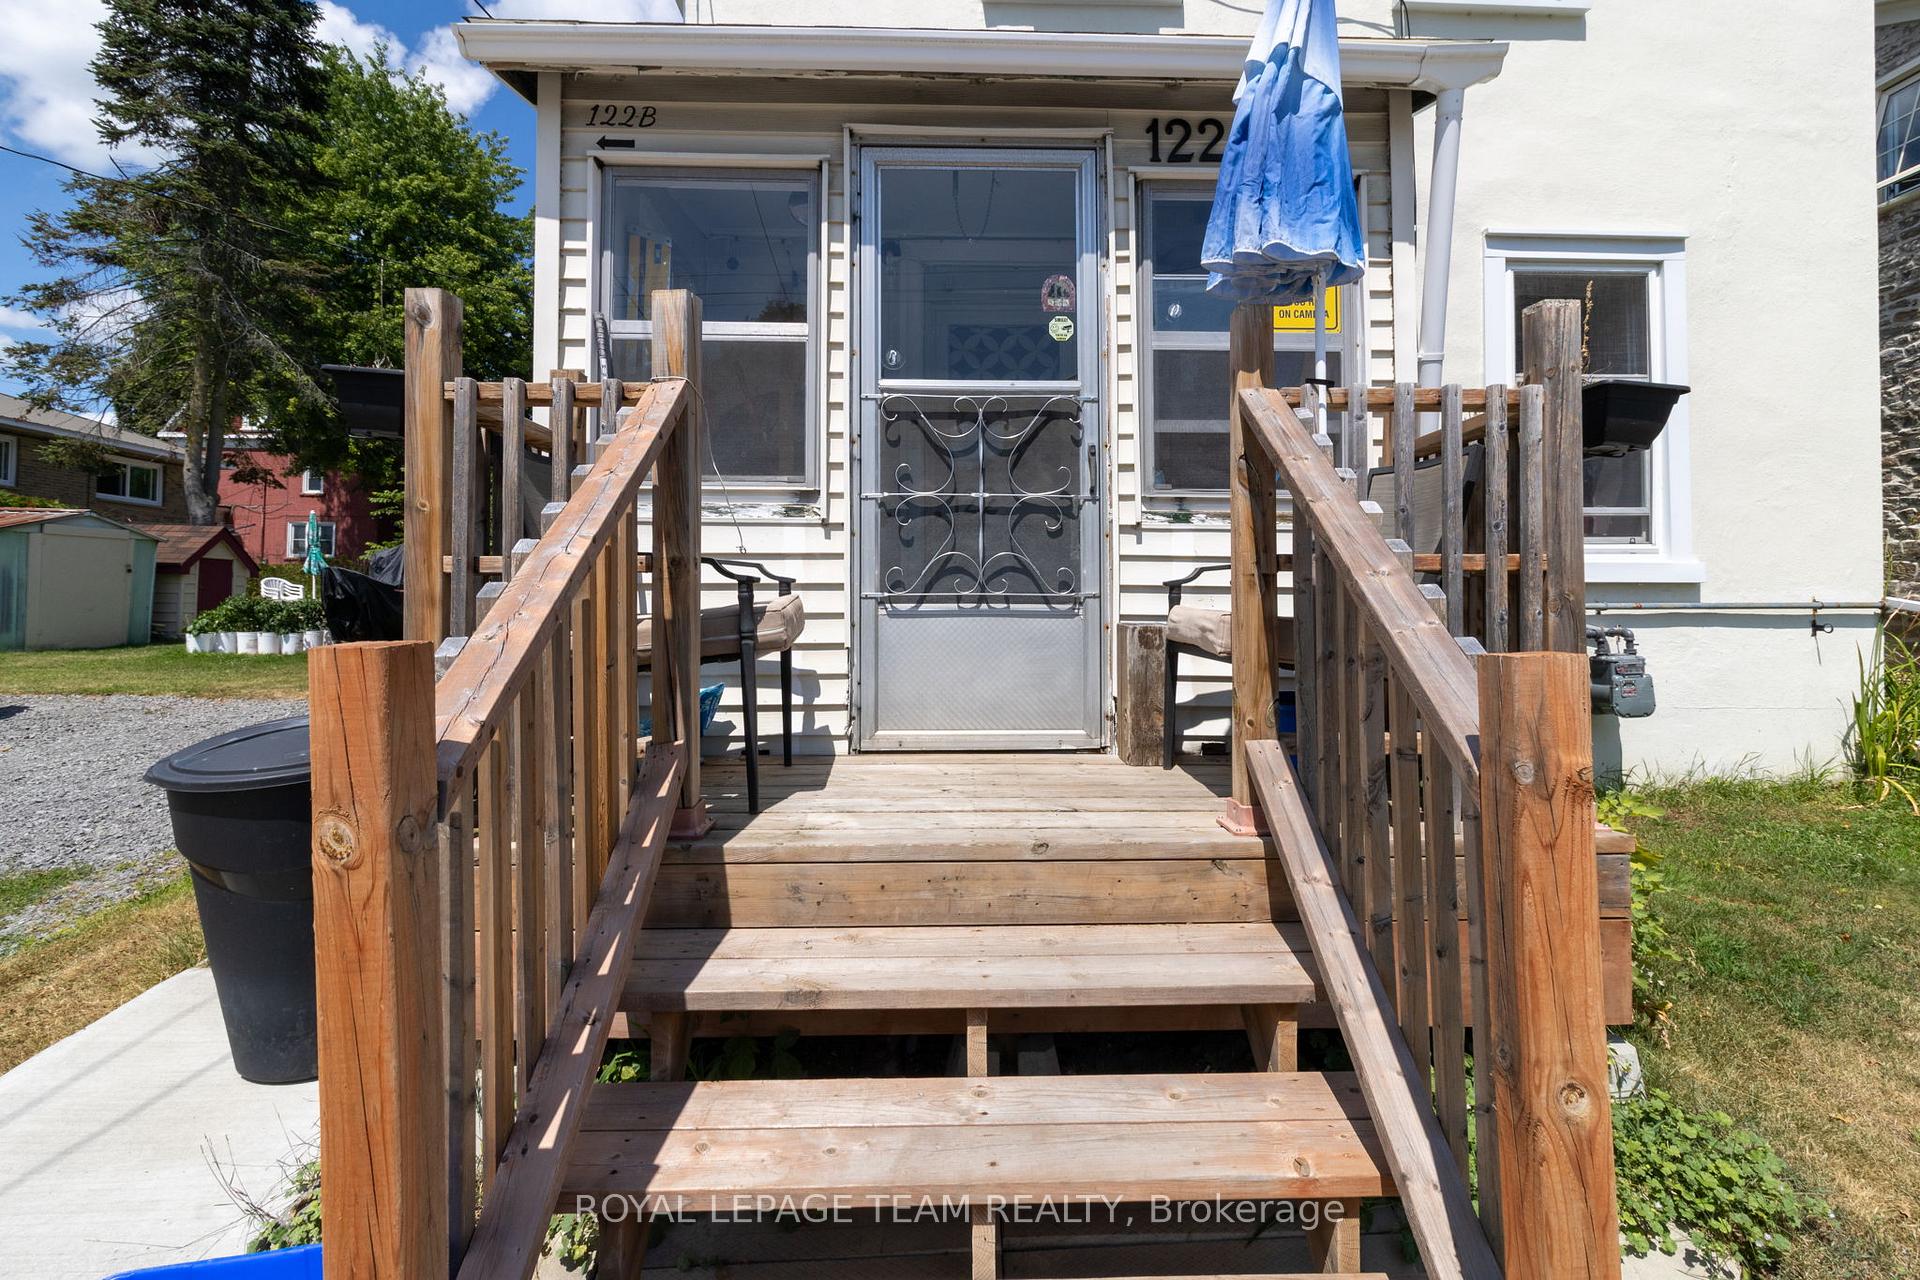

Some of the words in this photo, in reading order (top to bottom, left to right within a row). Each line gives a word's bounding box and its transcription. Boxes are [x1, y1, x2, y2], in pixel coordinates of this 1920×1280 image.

[584, 104, 657, 128] 122B
[1145, 117, 1226, 164] 122
[1278, 309, 1291, 319] ON
[1293, 309, 1330, 319] CAMA
